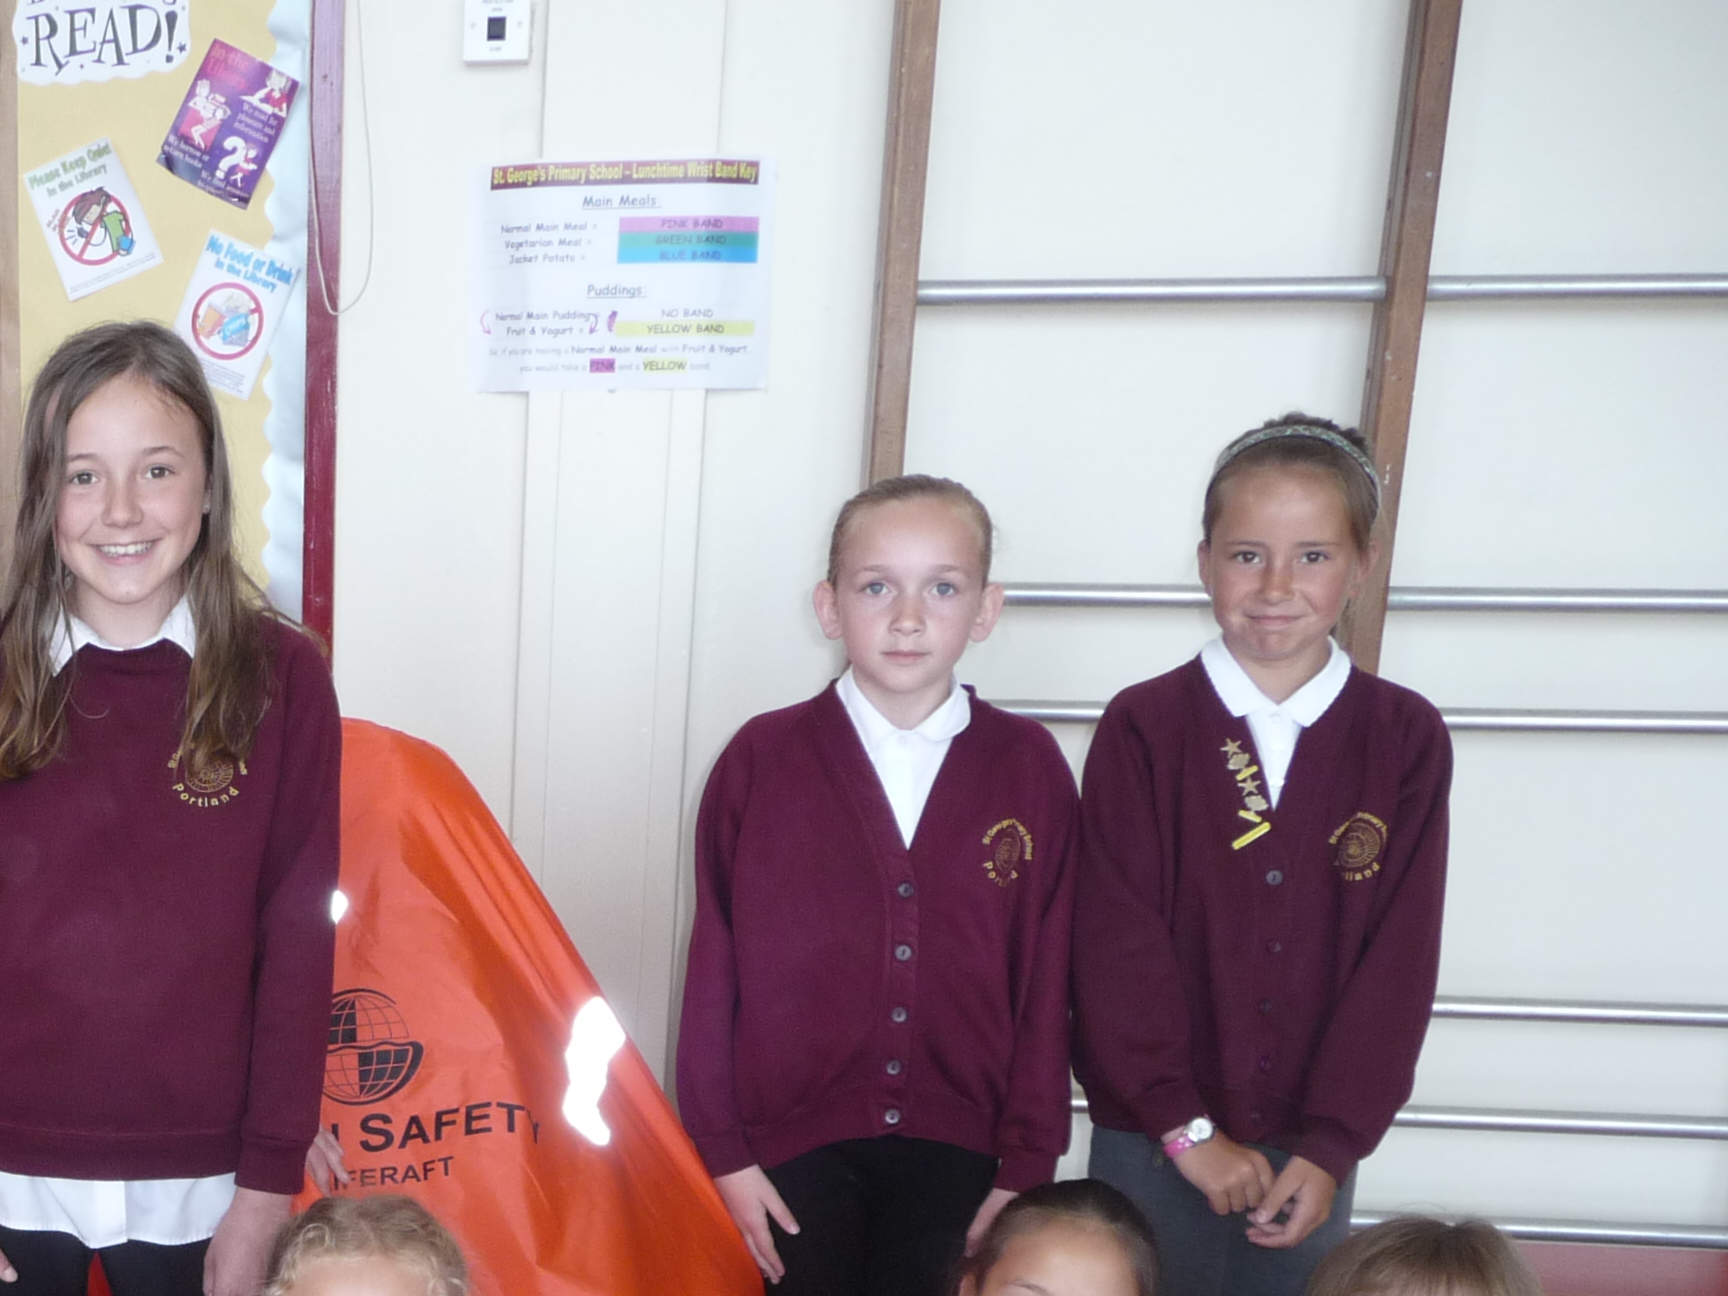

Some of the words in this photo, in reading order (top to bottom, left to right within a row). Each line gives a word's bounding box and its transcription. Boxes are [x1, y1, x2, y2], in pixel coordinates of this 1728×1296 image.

[25, 4, 179, 76] READ!
[28, 166, 61, 190] Please
[60, 155, 87, 176] Keep
[74, 164, 108, 185] Library
[507, 165, 546, 186] George's
[548, 164, 587, 184] Primary
[589, 162, 623, 181] School
[632, 161, 685, 179] Lunchtime
[687, 160, 714, 178] Wrist
[715, 161, 738, 178] Band
[738, 161, 757, 183] Key
[582, 196, 613, 208] Main
[501, 223, 532, 234] Normal
[535, 222, 559, 232] Main
[563, 221, 588, 231] Meal
[693, 218, 723, 229] BAND
[505, 238, 554, 251] Vegetarian
[557, 237, 582, 247] Meal
[655, 235, 693, 245] GREEN
[697, 234, 726, 245] BAND
[206, 234, 224, 256] No
[224, 243, 254, 268] Food
[253, 257, 267, 273] or
[266, 259, 294, 286] Drink
[509, 253, 538, 265] Jacket
[542, 253, 575, 263] Potato
[691, 250, 722, 260] BAND
[242, 268, 278, 294] Library
[526, 310, 548, 320] Main
[552, 310, 590, 323] Pudding
[661, 308, 679, 318] NO
[683, 308, 714, 318] BAND
[506, 326, 526, 336] Fruit
[541, 326, 574, 339] Yogurt
[647, 324, 693, 334] YELLOW
[696, 324, 725, 334] BAND
[609, 345, 631, 354] Main
[635, 344, 658, 353] Meal
[682, 344, 706, 353] Fruit
[643, 360, 687, 371] YELLOW
[173, 783, 240, 808] Portland
[329, 1156, 455, 1192] IFERAFT
